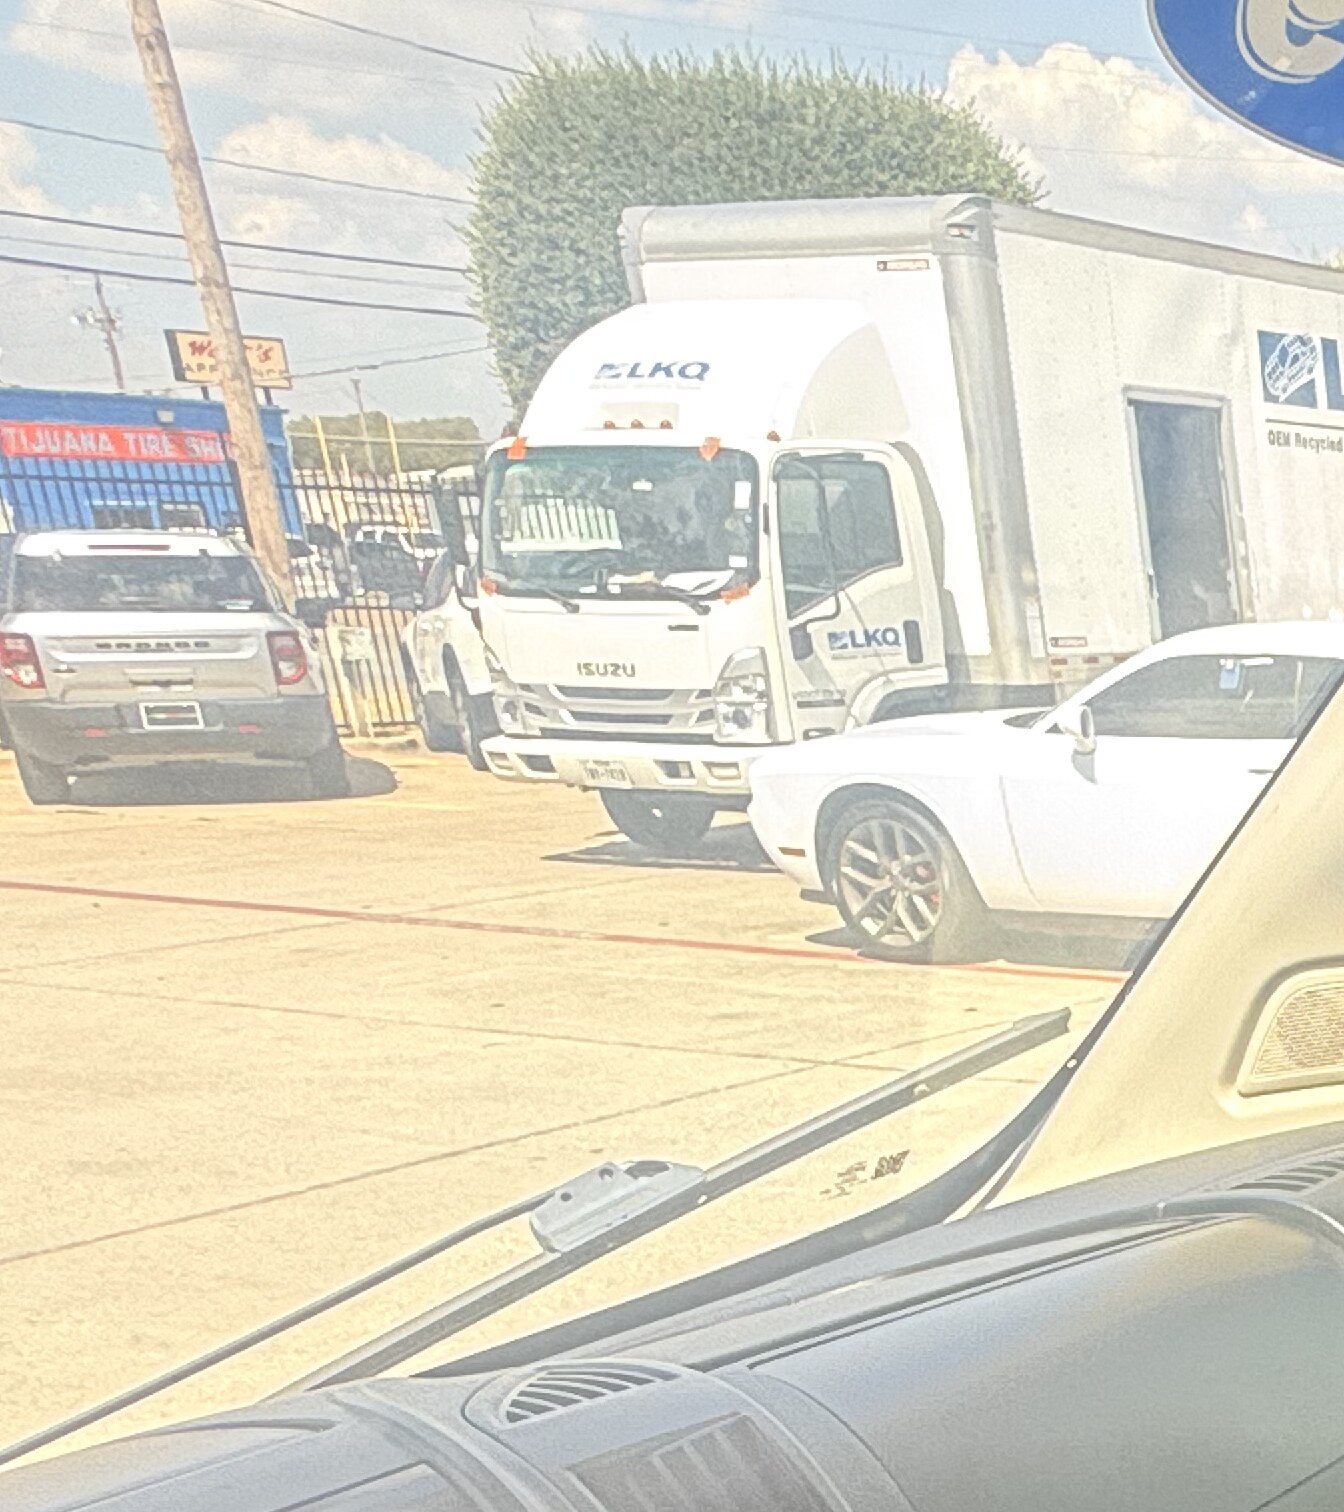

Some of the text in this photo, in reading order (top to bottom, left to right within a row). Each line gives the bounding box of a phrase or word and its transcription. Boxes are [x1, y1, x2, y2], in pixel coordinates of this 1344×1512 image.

[626, 361, 711, 381] LKQ
[1, 426, 116, 455] TIJUANA
[1268, 429, 1291, 447] OEM
[1294, 432, 1343, 454] Recycled
[850, 627, 901, 648] LKQ
[576, 662, 636, 678] ISUZU
